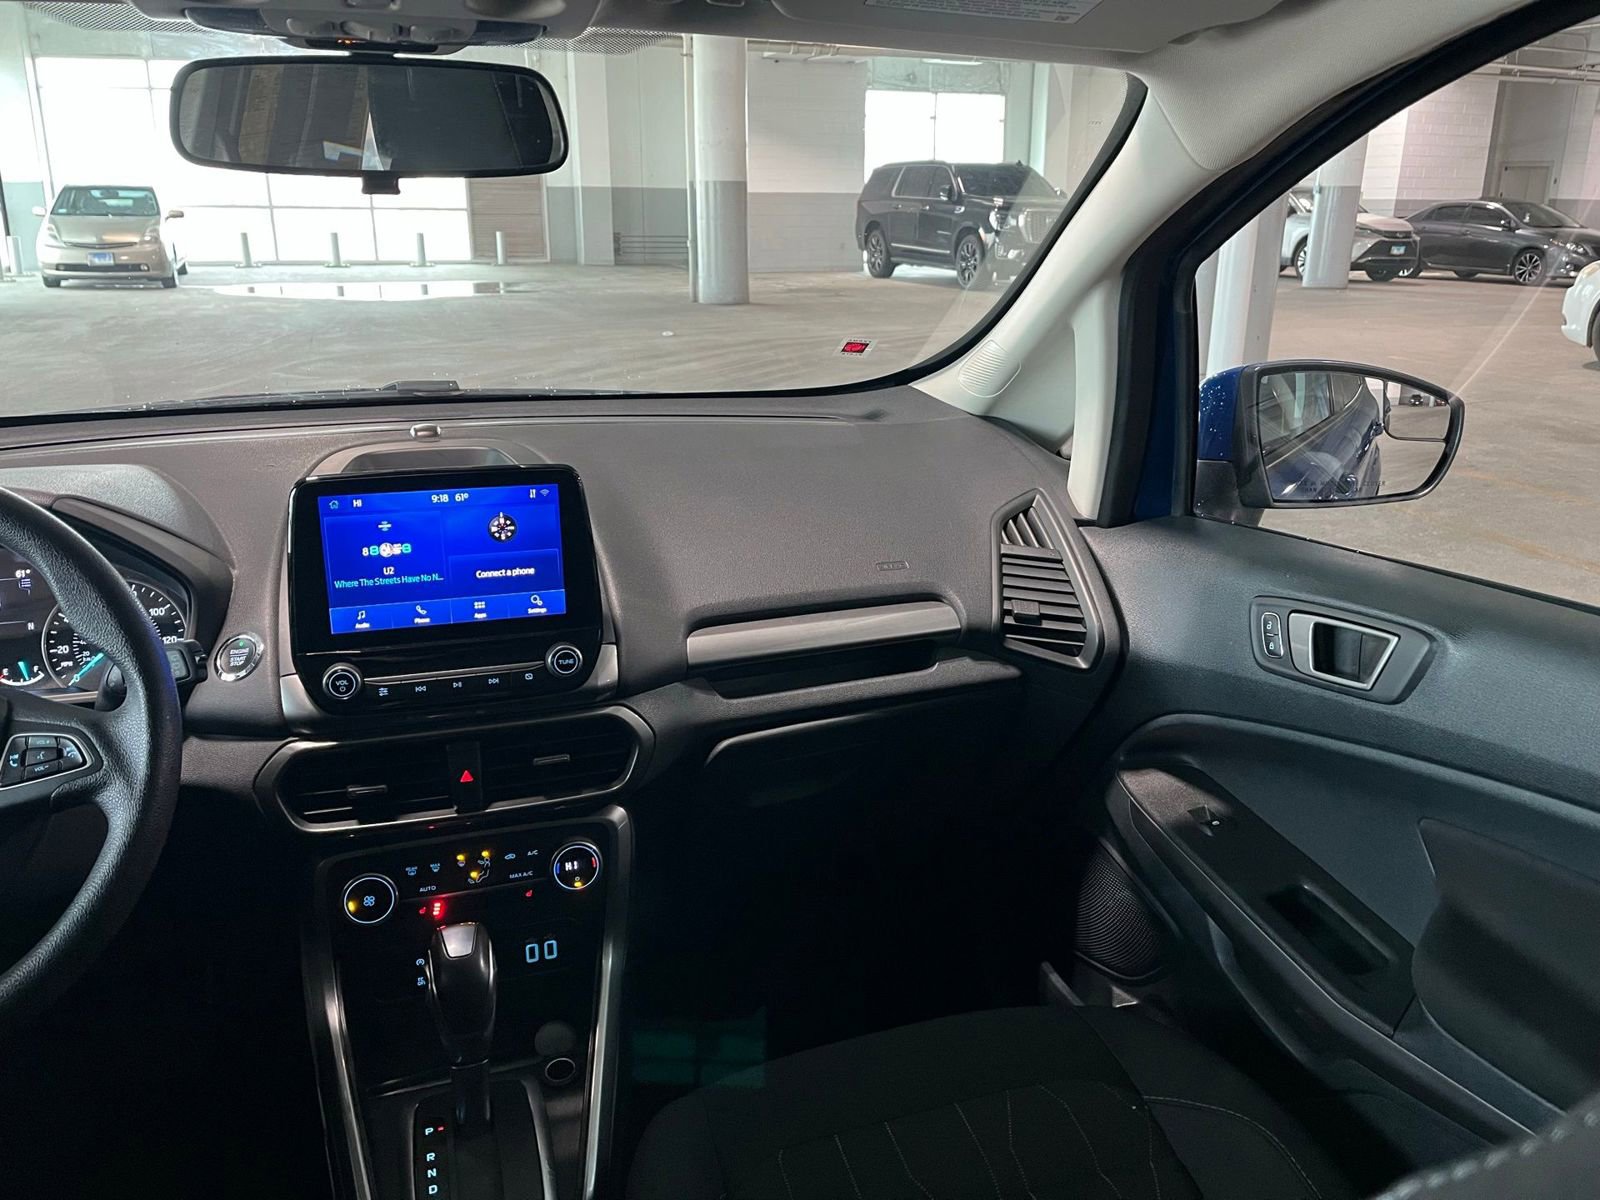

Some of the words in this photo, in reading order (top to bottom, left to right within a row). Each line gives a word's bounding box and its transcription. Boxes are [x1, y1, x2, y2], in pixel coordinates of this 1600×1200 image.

[431, 493, 449, 504] 9:18
[454, 492, 469, 502] 61°
[352, 499, 363, 508] HI
[383, 566, 395, 576] U2
[475, 568, 506, 579] Connect
[512, 567, 535, 577] phone
[333, 579, 359, 589] Where
[358, 577, 375, 587] The
[374, 575, 401, 586] Streets
[401, 574, 421, 583] Have
[421, 573, 432, 582] No
[149, 608, 165, 618] 100
[161, 636, 178, 645] 120
[56, 645, 69, 655] 20
[558, 658, 574, 666] TUNE
[527, 849, 539, 857] A/C
[509, 871, 522, 880] MAX
[522, 869, 534, 878] A/C
[419, 885, 437, 893] AUTO
[424, 1127, 434, 1136] P
[426, 1152, 436, 1162] R
[427, 1167, 437, 1178] N
[428, 1184, 438, 1195] D
